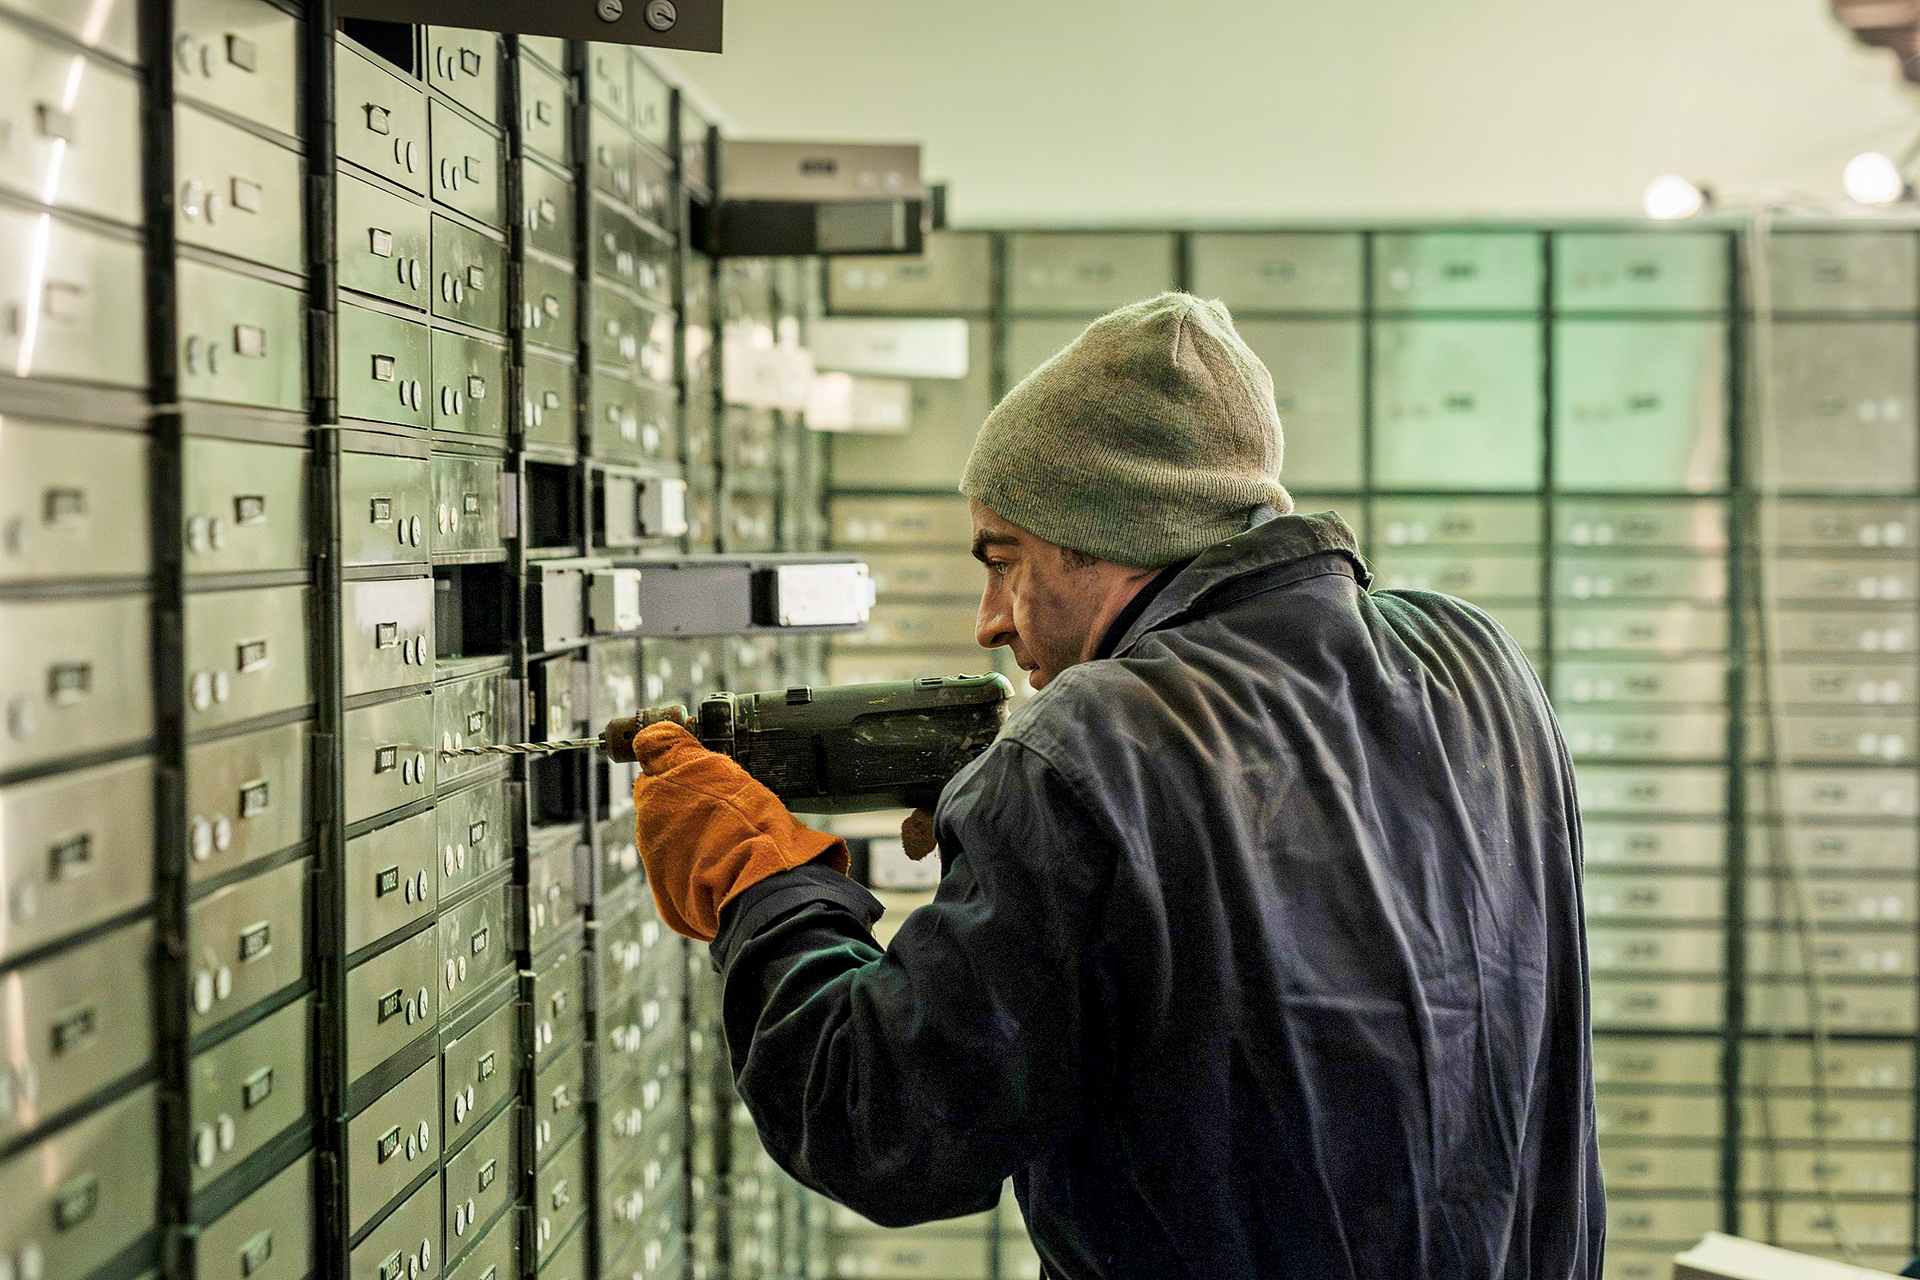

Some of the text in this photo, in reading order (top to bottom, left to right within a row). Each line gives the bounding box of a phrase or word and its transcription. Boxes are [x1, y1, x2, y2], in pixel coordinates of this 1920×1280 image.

[381, 750, 394, 767] 0081
[383, 871, 396, 890] 0082
[384, 994, 398, 1015] 0083
